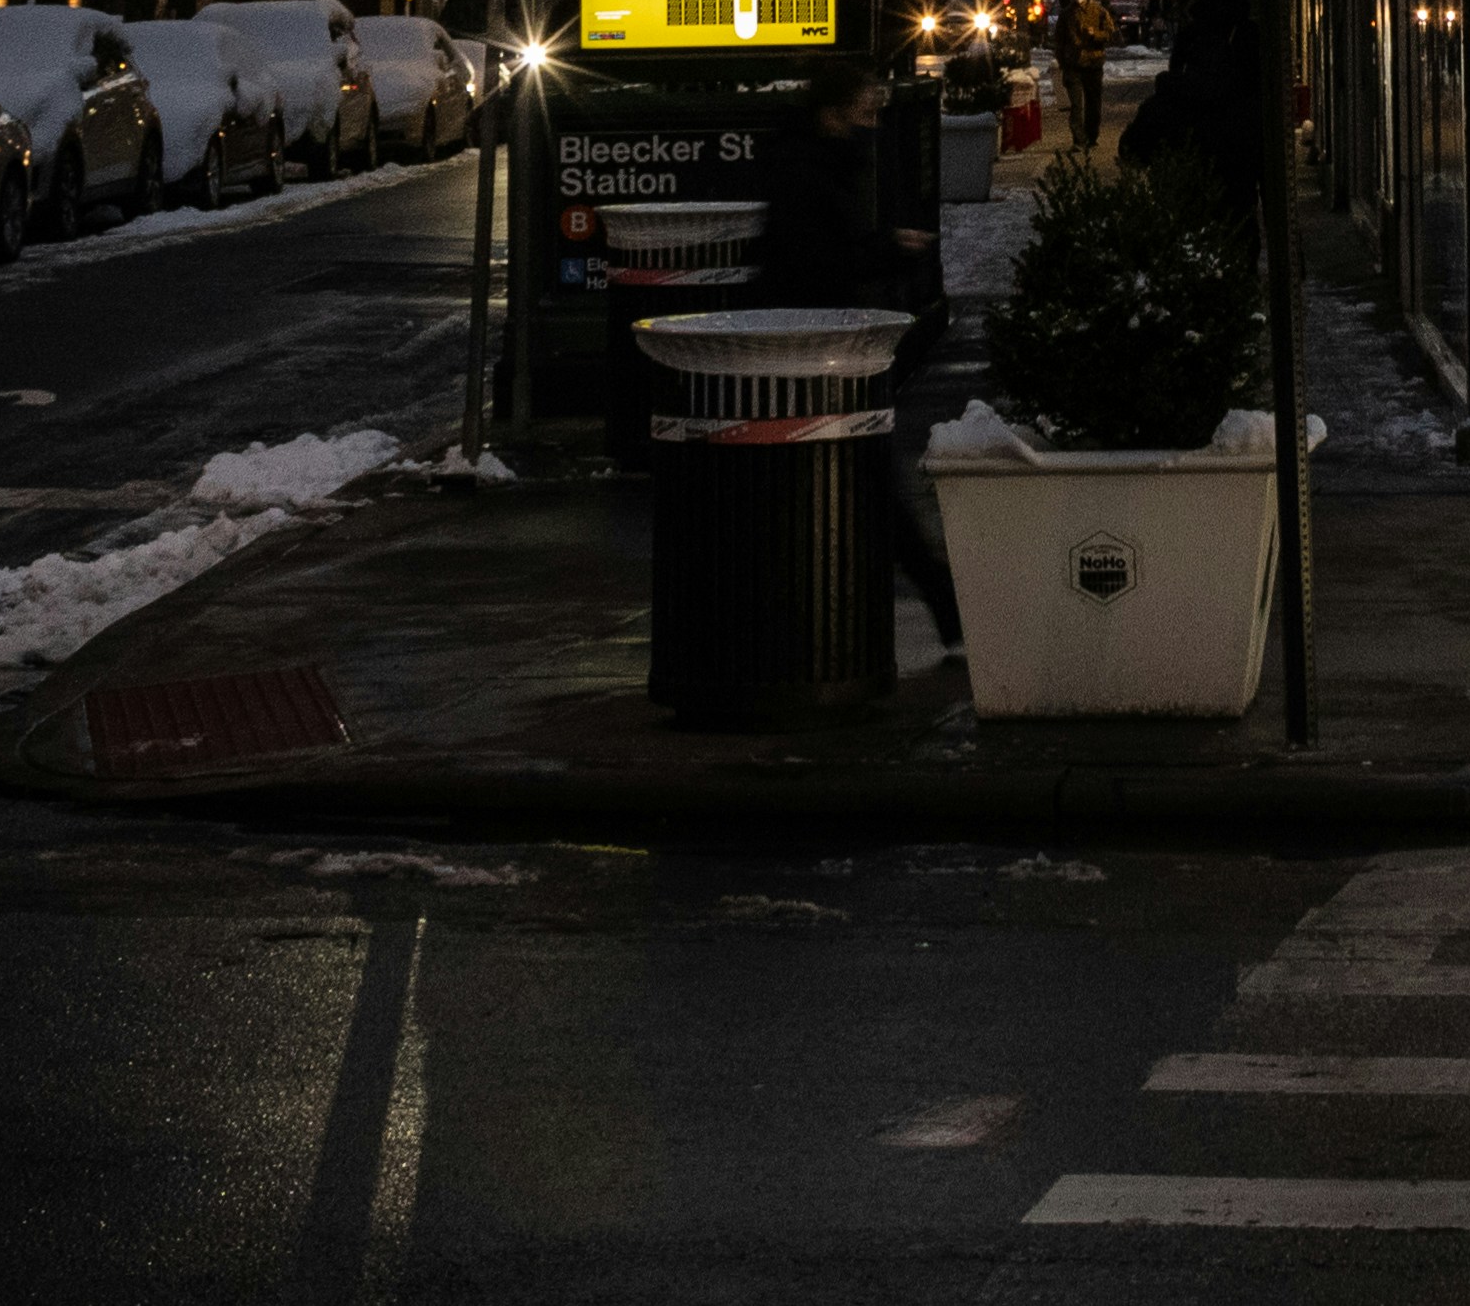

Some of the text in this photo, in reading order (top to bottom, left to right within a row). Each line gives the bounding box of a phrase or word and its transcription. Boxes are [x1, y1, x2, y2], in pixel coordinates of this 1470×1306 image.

[801, 27, 829, 37] NYC
[558, 132, 755, 165] Bleecker St
[558, 166, 678, 197] Station
[570, 212, 589, 233] B
[1079, 555, 1126, 569] NoHo
